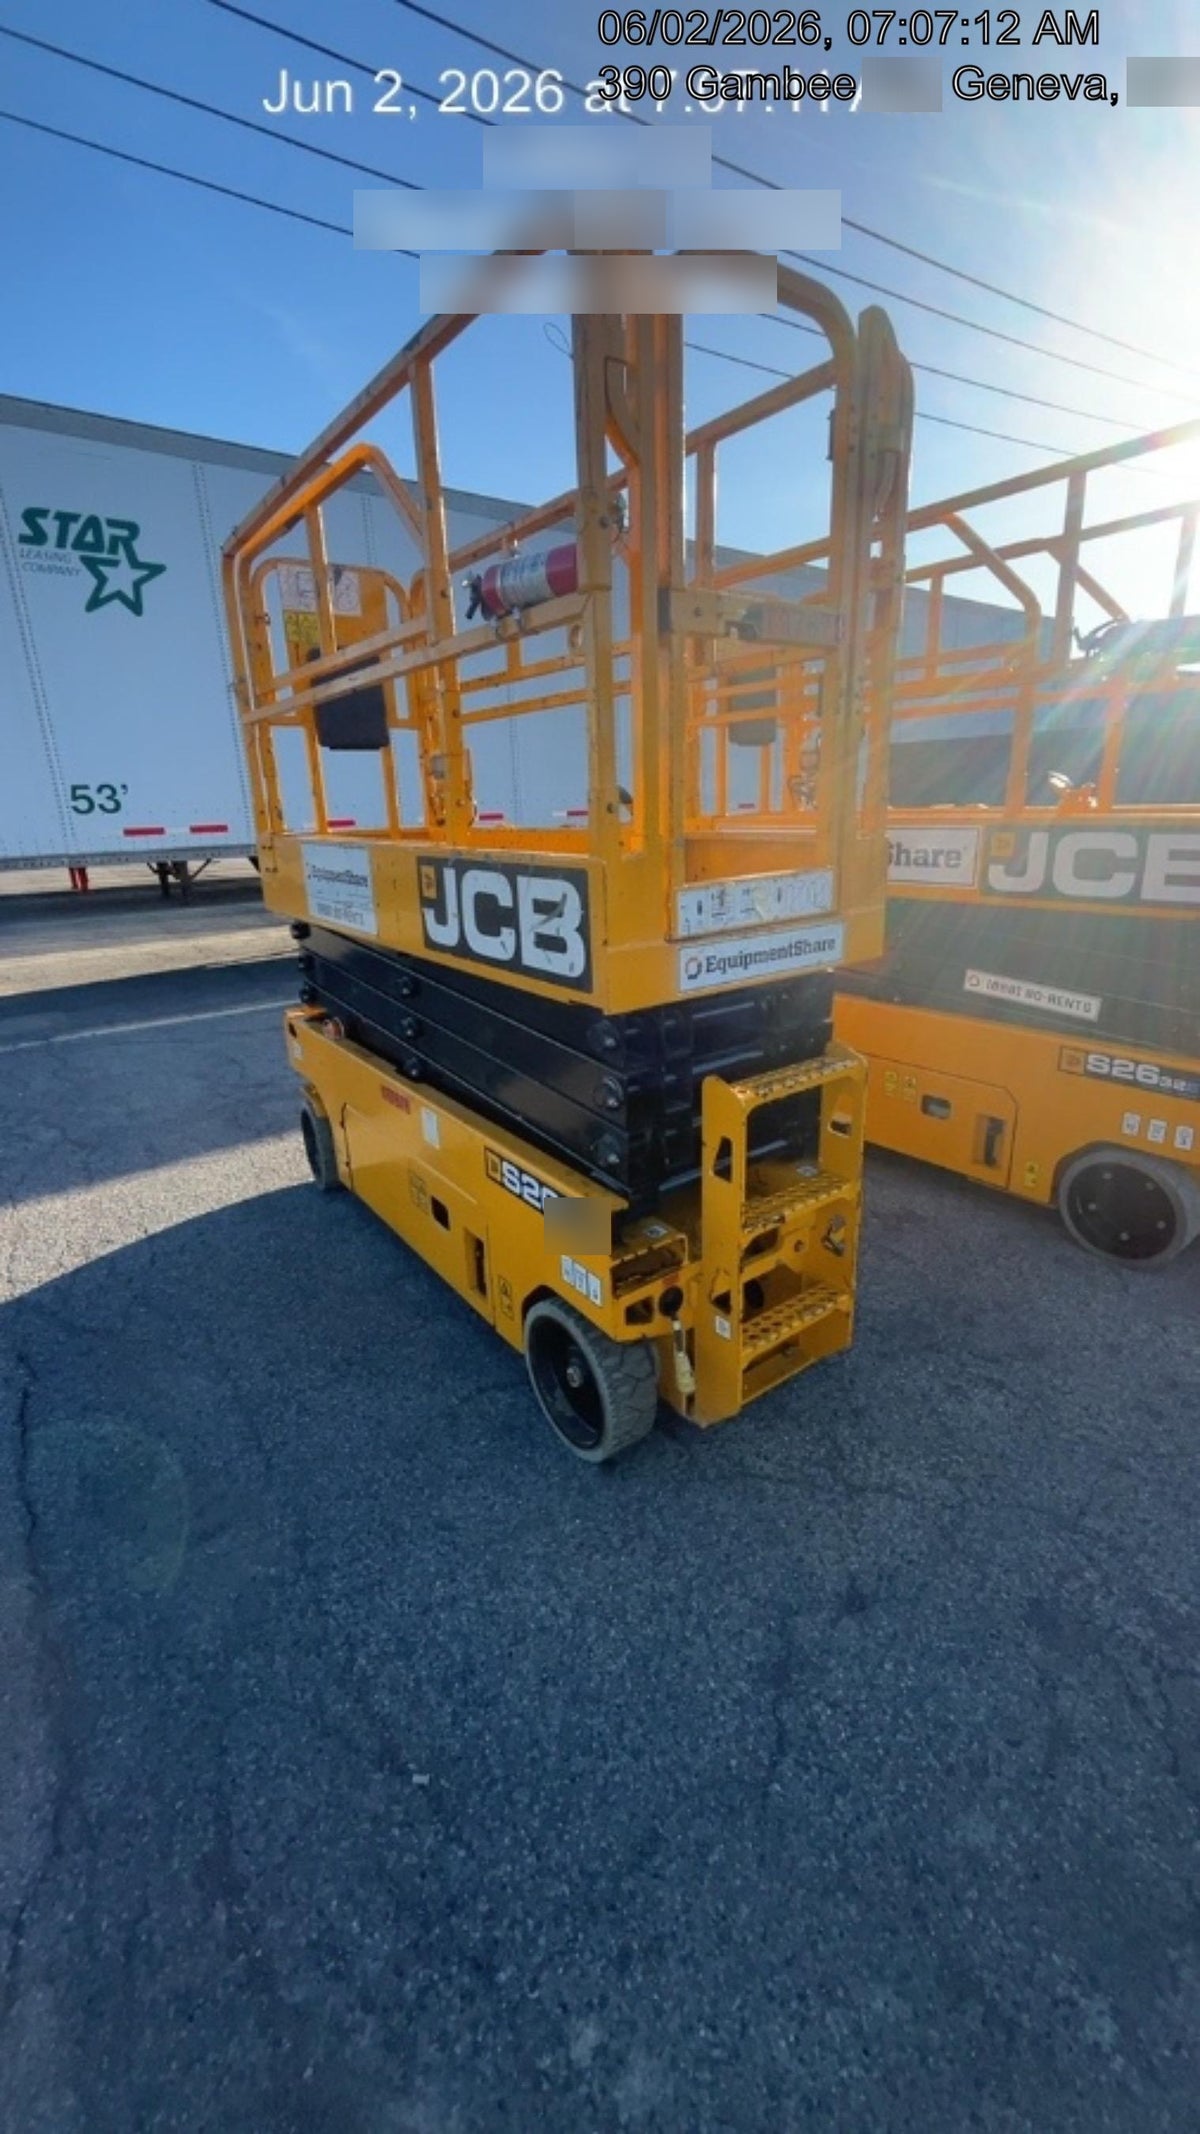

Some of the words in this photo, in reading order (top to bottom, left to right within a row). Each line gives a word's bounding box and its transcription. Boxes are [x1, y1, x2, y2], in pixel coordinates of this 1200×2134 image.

[18, 507, 140, 556] STAR
[70, 783, 129, 815] 53'
[424, 866, 585, 979] JCB
[705, 938, 836, 975] EquipmentShare
